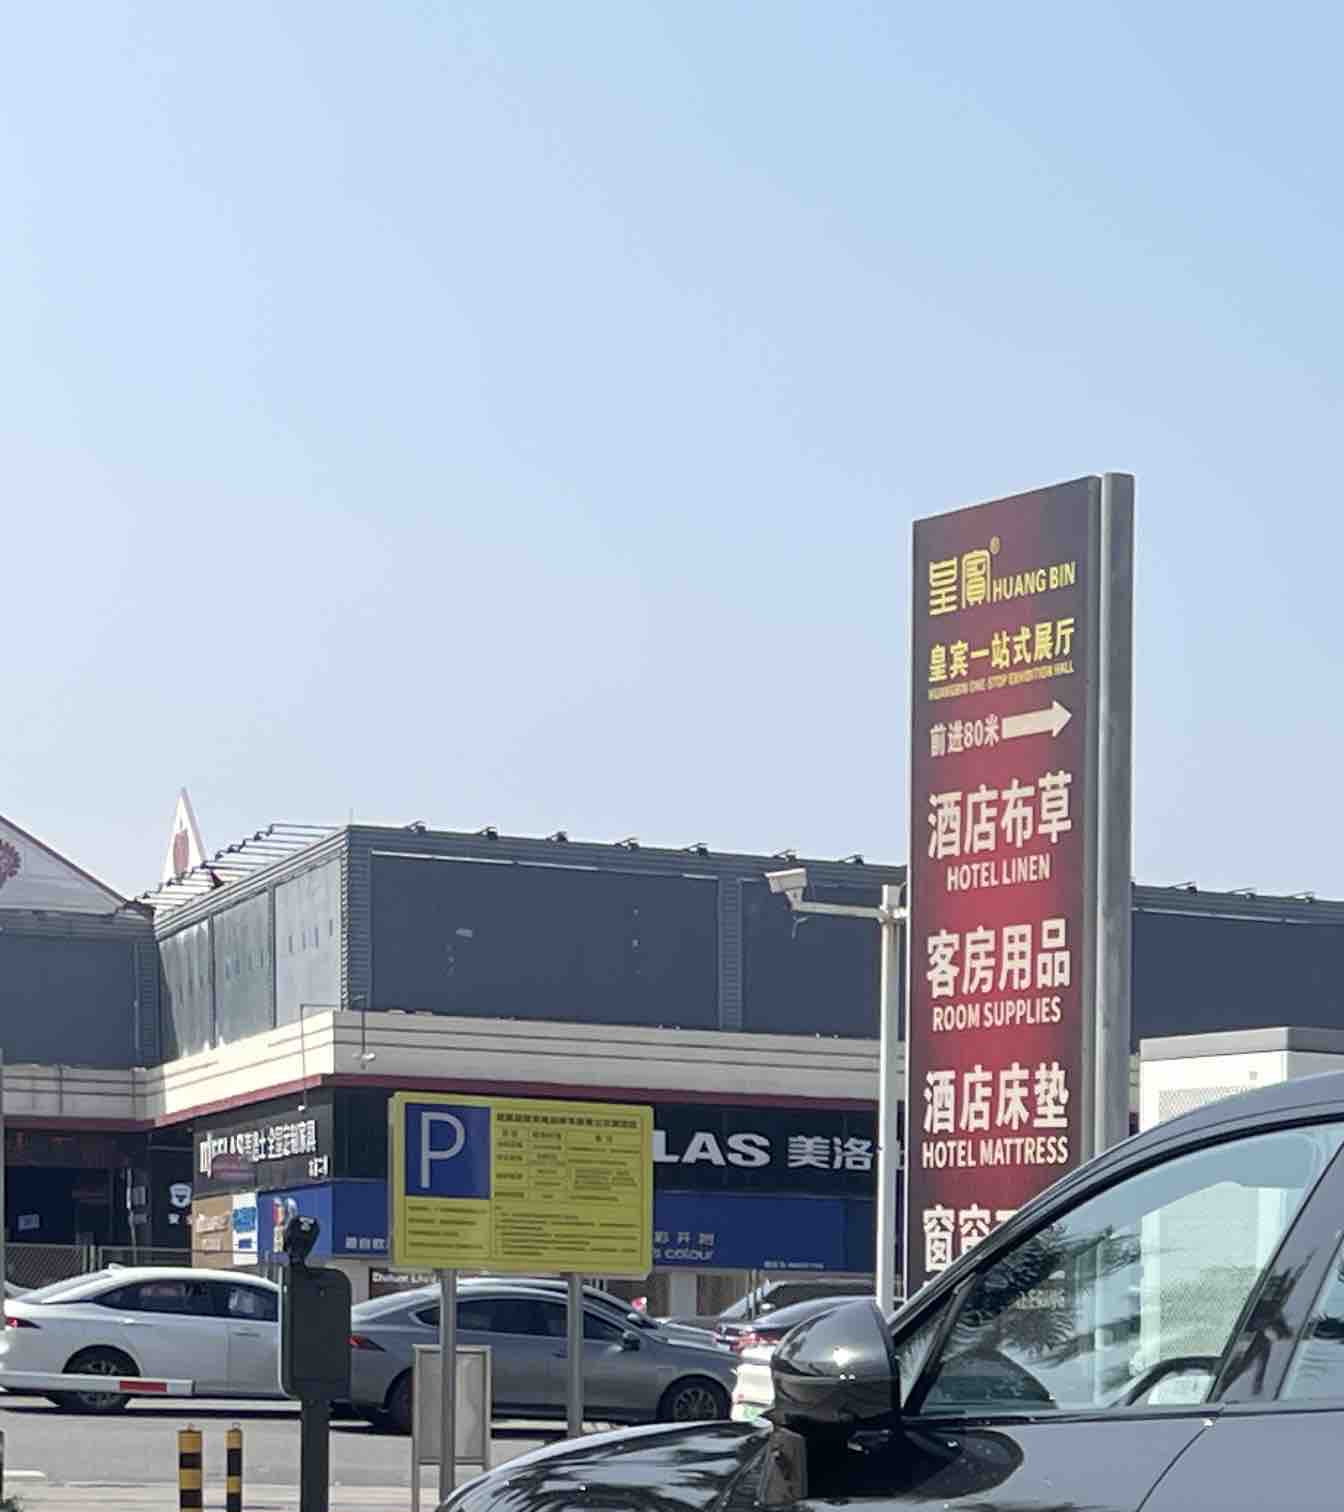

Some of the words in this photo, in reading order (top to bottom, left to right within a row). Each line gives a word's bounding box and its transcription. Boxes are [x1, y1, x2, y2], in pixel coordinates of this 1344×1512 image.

[992, 569, 1046, 602] HUANG
[1050, 561, 1076, 589] BIN
[928, 618, 1075, 682] 皇宾一站式展厅
[930, 713, 999, 757] 前进80米
[928, 770, 1072, 859] 酒店布草
[947, 861, 999, 892] HOTEL
[1002, 853, 1050, 885] LINEN
[926, 918, 1070, 998] 客房用品
[932, 1003, 980, 1032] ROOM
[983, 996, 1061, 1027] SUPPLIES
[923, 1061, 1069, 1134] 酒店床垫
[421, 1112, 465, 1189] P
[787, 1135, 904, 1171] 美洛
[922, 1139, 976, 1168] HOTEL
[980, 1136, 1068, 1166] MATTRESS
[923, 1204, 1018, 1272] 窗帘
